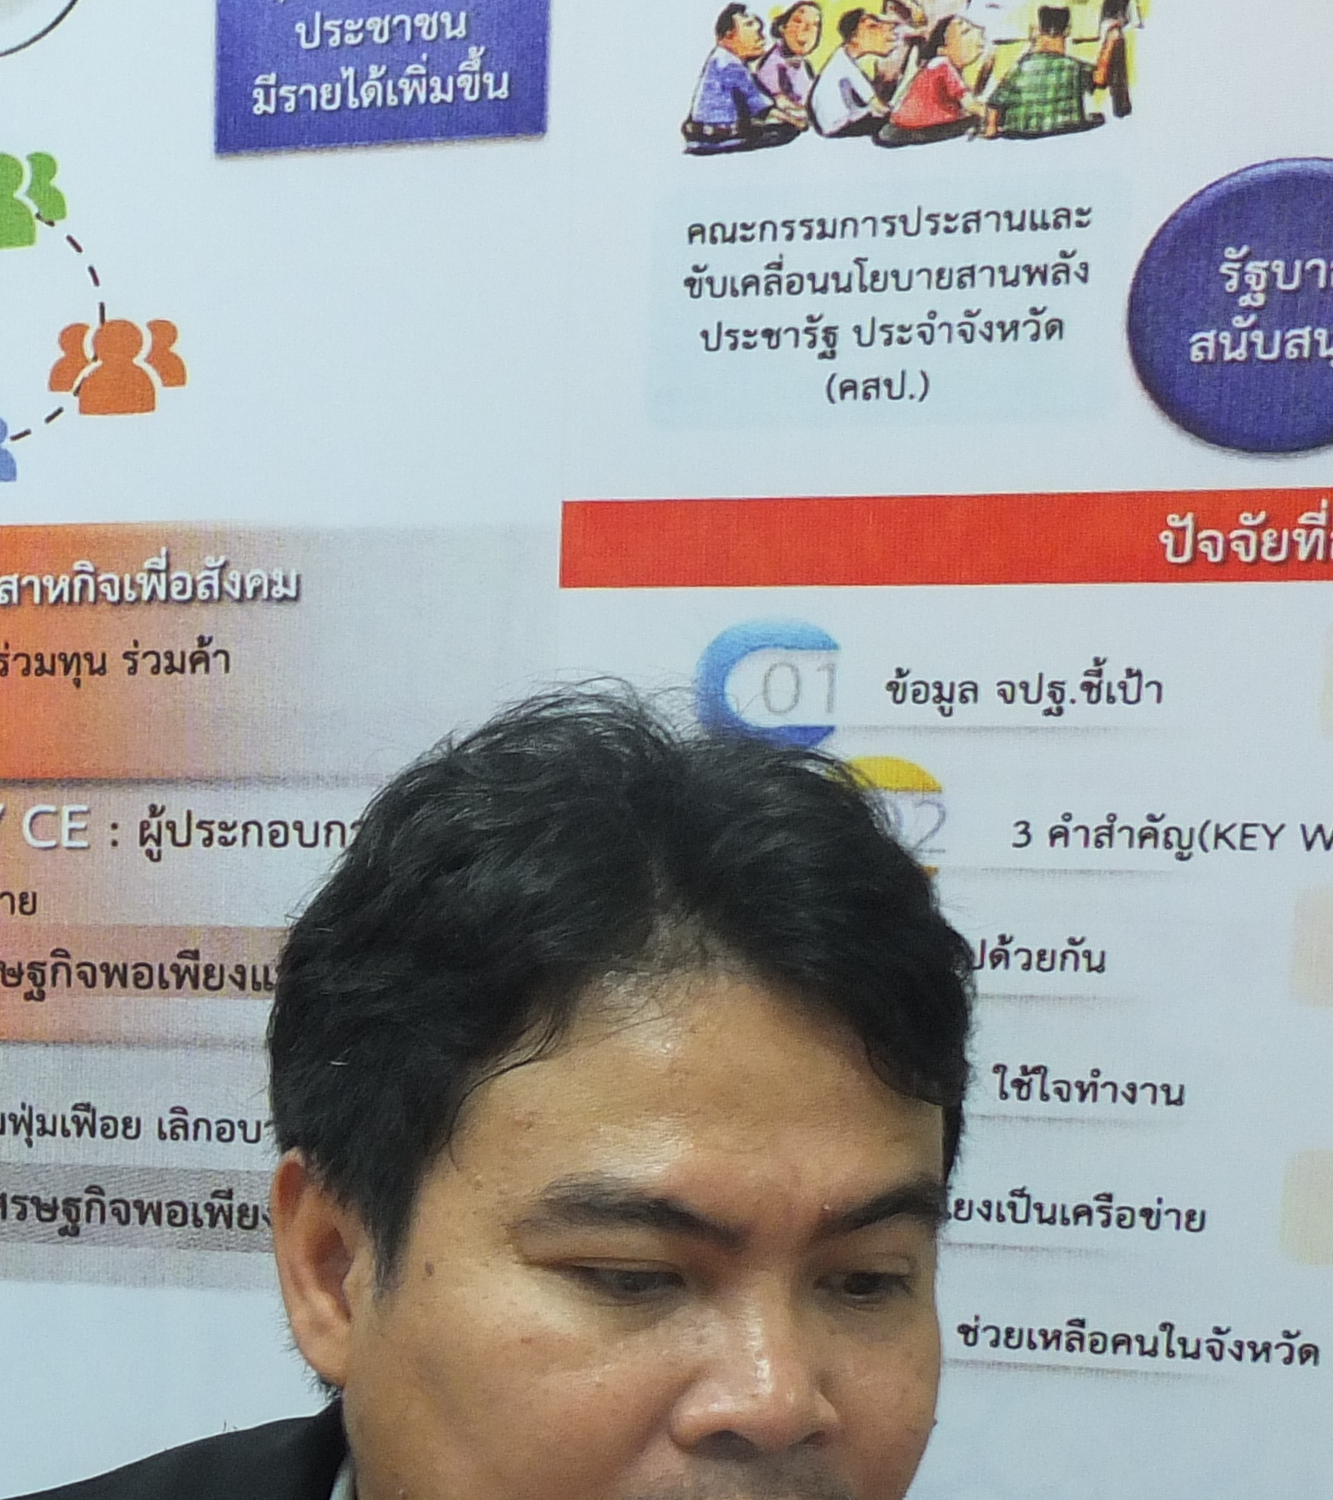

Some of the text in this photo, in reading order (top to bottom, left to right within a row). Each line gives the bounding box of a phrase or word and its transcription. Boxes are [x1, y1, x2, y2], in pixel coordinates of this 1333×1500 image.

[294, 9, 467, 49] ประชาชน
[251, 46, 510, 116] มีรายได้เพิ่มขึ้น
[686, 203, 1092, 246] คณะกรรมการประสานและ
[683, 251, 1090, 302] ขับเคลื่อนนโยบายสานพลัง
[1219, 244, 1333, 308] รัฐบา
[700, 307, 1065, 360] ประชารัฐ ประจำจังหวัด
[1188, 313, 1333, 367] สนับสน
[825, 369, 931, 404] (คสป.)
[1158, 498, 1333, 564] ปัจจัยที่
[123, 635, 232, 677] ร่วมค้า
[886, 656, 1165, 718] ข้อมูล จปฐ.ชี้เป้า
[22, 804, 90, 849] CE
[1012, 821, 1033, 850] 3
[993, 1064, 1186, 1108] ใช้ใจทำงาน
[945, 1186, 1207, 1233] ยงเป็นเครือข่าย
[957, 1316, 1321, 1368] ช่วยเหลือคนในจังหวัด
